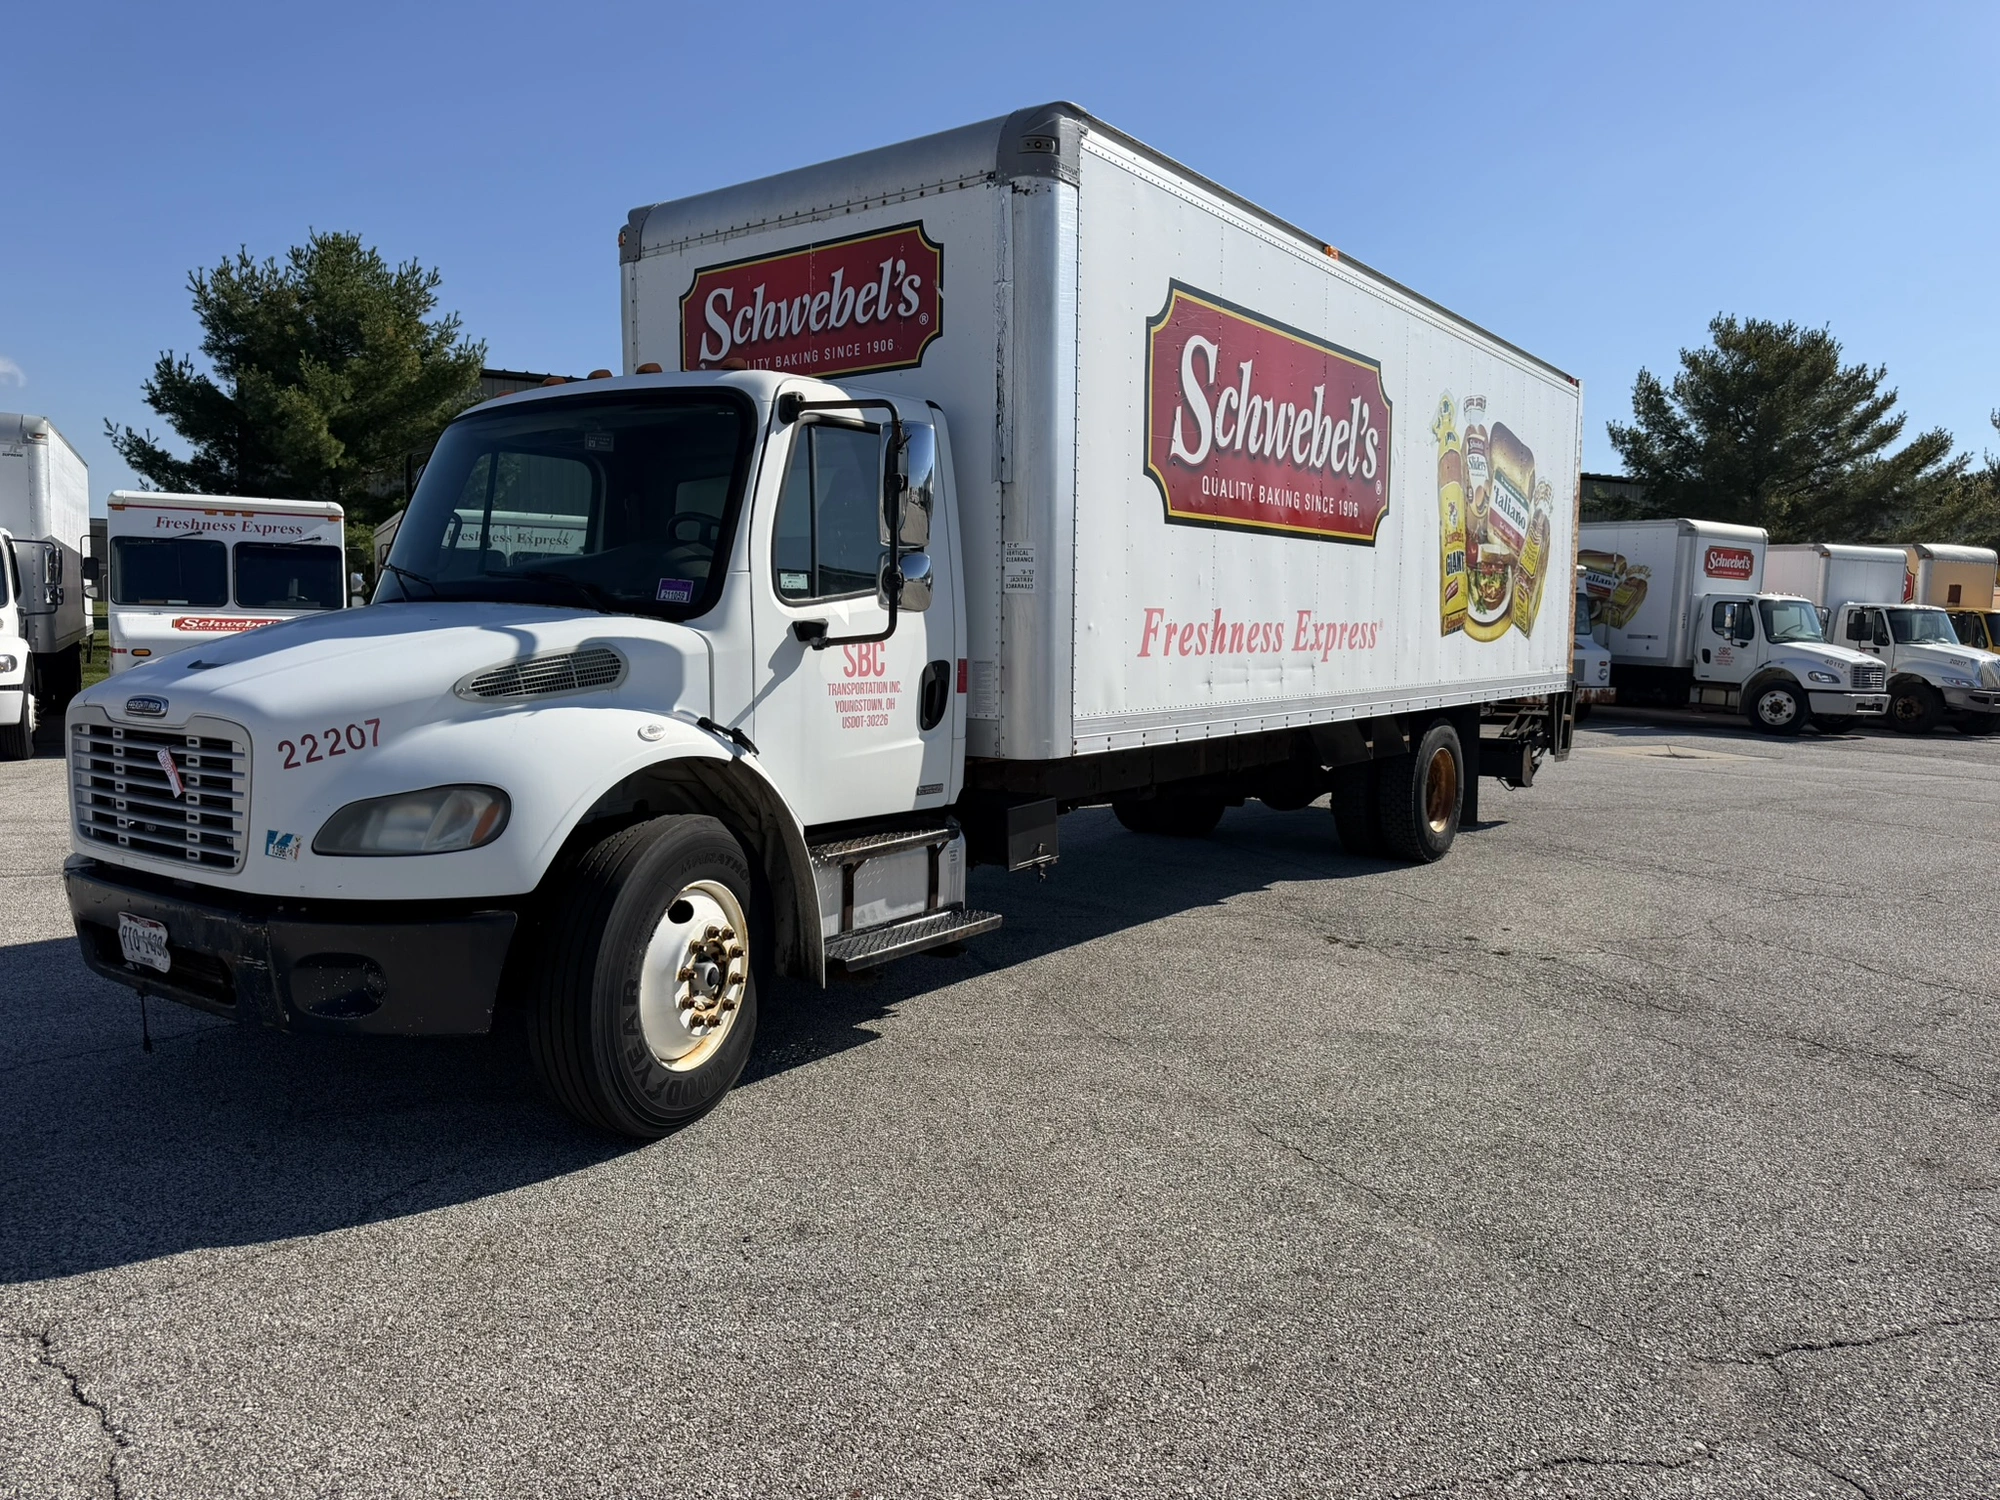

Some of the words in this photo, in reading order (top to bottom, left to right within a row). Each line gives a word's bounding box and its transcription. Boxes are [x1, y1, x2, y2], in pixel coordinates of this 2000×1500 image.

[698, 257, 921, 363] Schwebel's
[775, 349, 819, 368] BAKING
[824, 343, 860, 361] SINCE
[866, 338, 894, 354] 1906
[1169, 335, 1379, 479] Schwebel's
[1202, 475, 1254, 502] QUALITY
[1259, 485, 1300, 508] BAKING
[1304, 492, 1334, 515] SINCE
[1338, 499, 1359, 518] 1906
[154, 516, 236, 532] Freshness
[241, 520, 303, 536] Express
[517, 533, 569, 547] Express
[1446, 551, 1465, 576] GIANT
[180, 618, 277, 629] Schwebel'
[1137, 608, 1284, 657] Freshness
[1292, 609, 1378, 662] Express
[842, 641, 885, 678] SBC
[1718, 646, 1731, 656] SBC
[1824, 658, 1845, 670] 40112
[1949, 658, 1967, 667] 20217
[827, 682, 887, 696] TRANSPORTATION
[835, 701, 885, 713] YOUNGSTOWN,
[886, 699, 896, 711] OH
[277, 718, 381, 770] 22207
